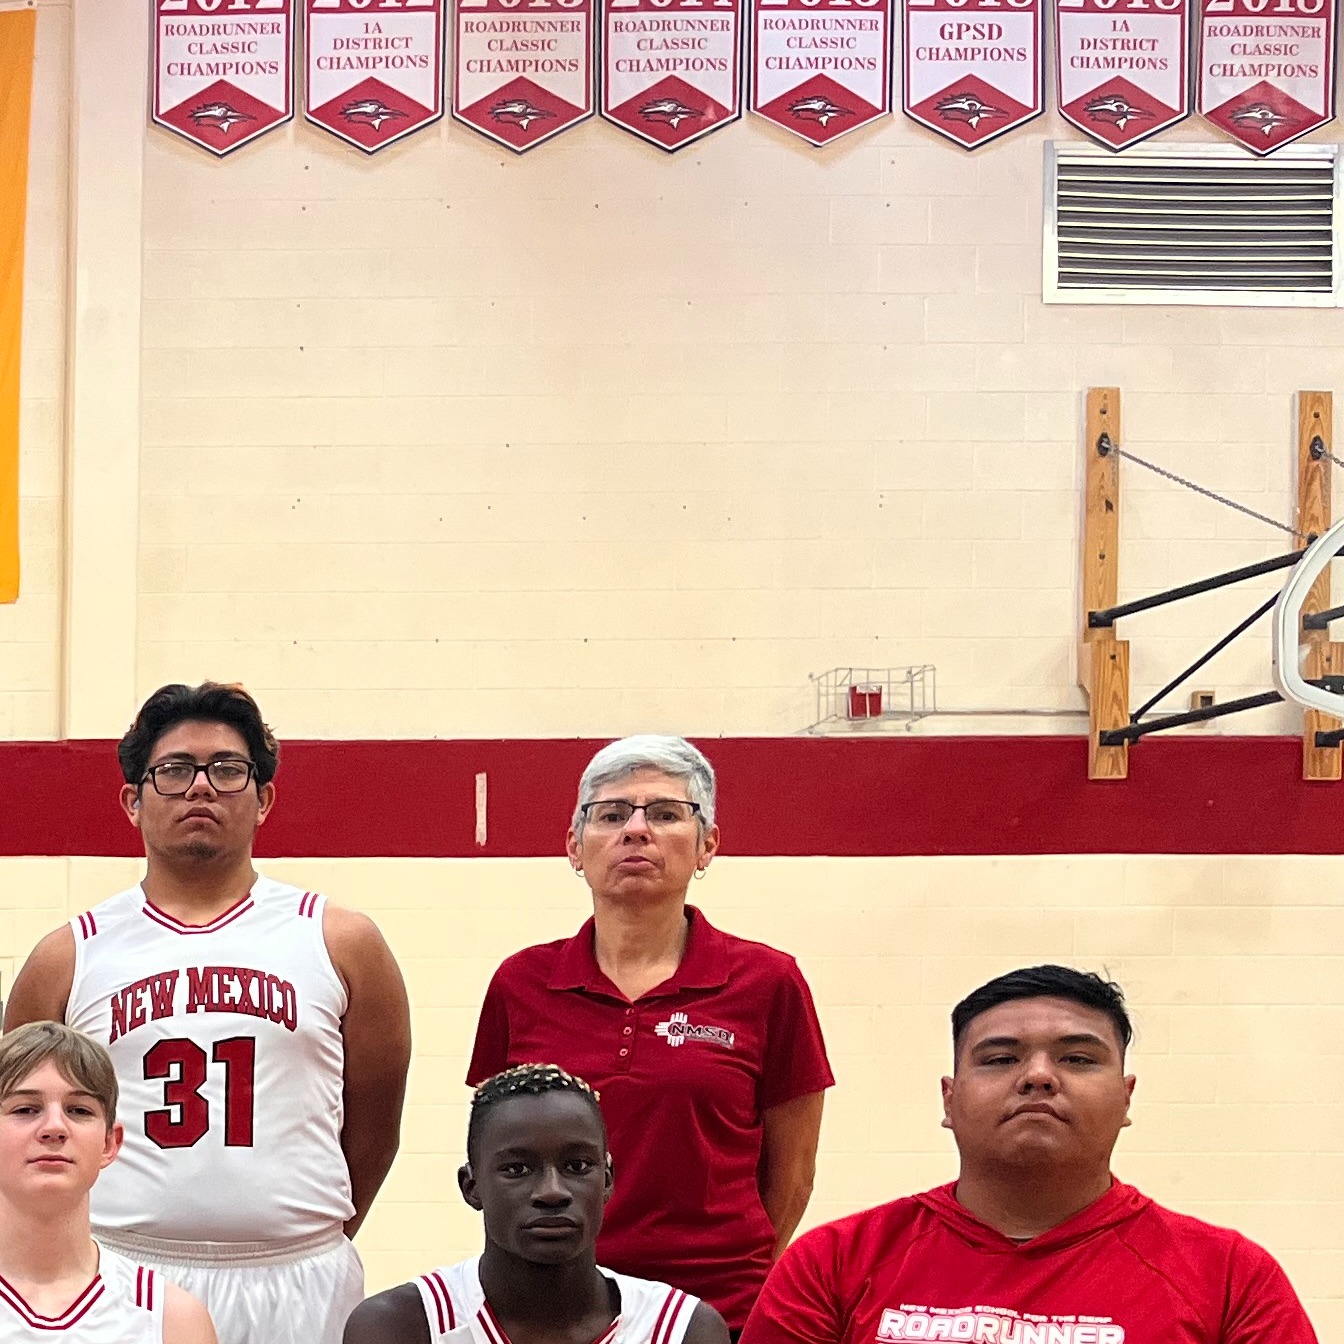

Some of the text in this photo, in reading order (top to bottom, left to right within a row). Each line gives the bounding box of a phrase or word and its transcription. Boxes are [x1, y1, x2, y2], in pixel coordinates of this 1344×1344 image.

[165, 22, 281, 36] ROADRUNNER
[464, 21, 580, 33] ROADRUNNER
[614, 20, 730, 32] ROADRUNNER
[764, 19, 879, 31] ROADRUNNER
[940, 23, 1003, 40] GPSD
[1207, 25, 1321, 38] ROADRUNNER
[188, 41, 257, 55] CLASSIC
[333, 37, 412, 50] DISTRICT
[488, 39, 557, 51] CLASSIC
[637, 38, 707, 50] CLASSIC
[787, 37, 856, 49] CLASSIC
[1080, 38, 1158, 51] DISTRICT
[916, 48, 1027, 62] CHAMPIONS
[1231, 44, 1299, 56] CLASSIC
[167, 61, 279, 76] CHAMPIONS
[317, 55, 429, 70] CHAMPIONS
[467, 59, 579, 72] CHAMPIONS
[616, 58, 727, 72] CHAMPIONS
[765, 57, 877, 70] CHAMPIONS
[1070, 56, 1168, 70] CHAMPIONS
[1209, 64, 1318, 78] CHAMPIONS
[109, 966, 297, 1045] NEW MEXICO
[143, 1036, 256, 1149] 31
